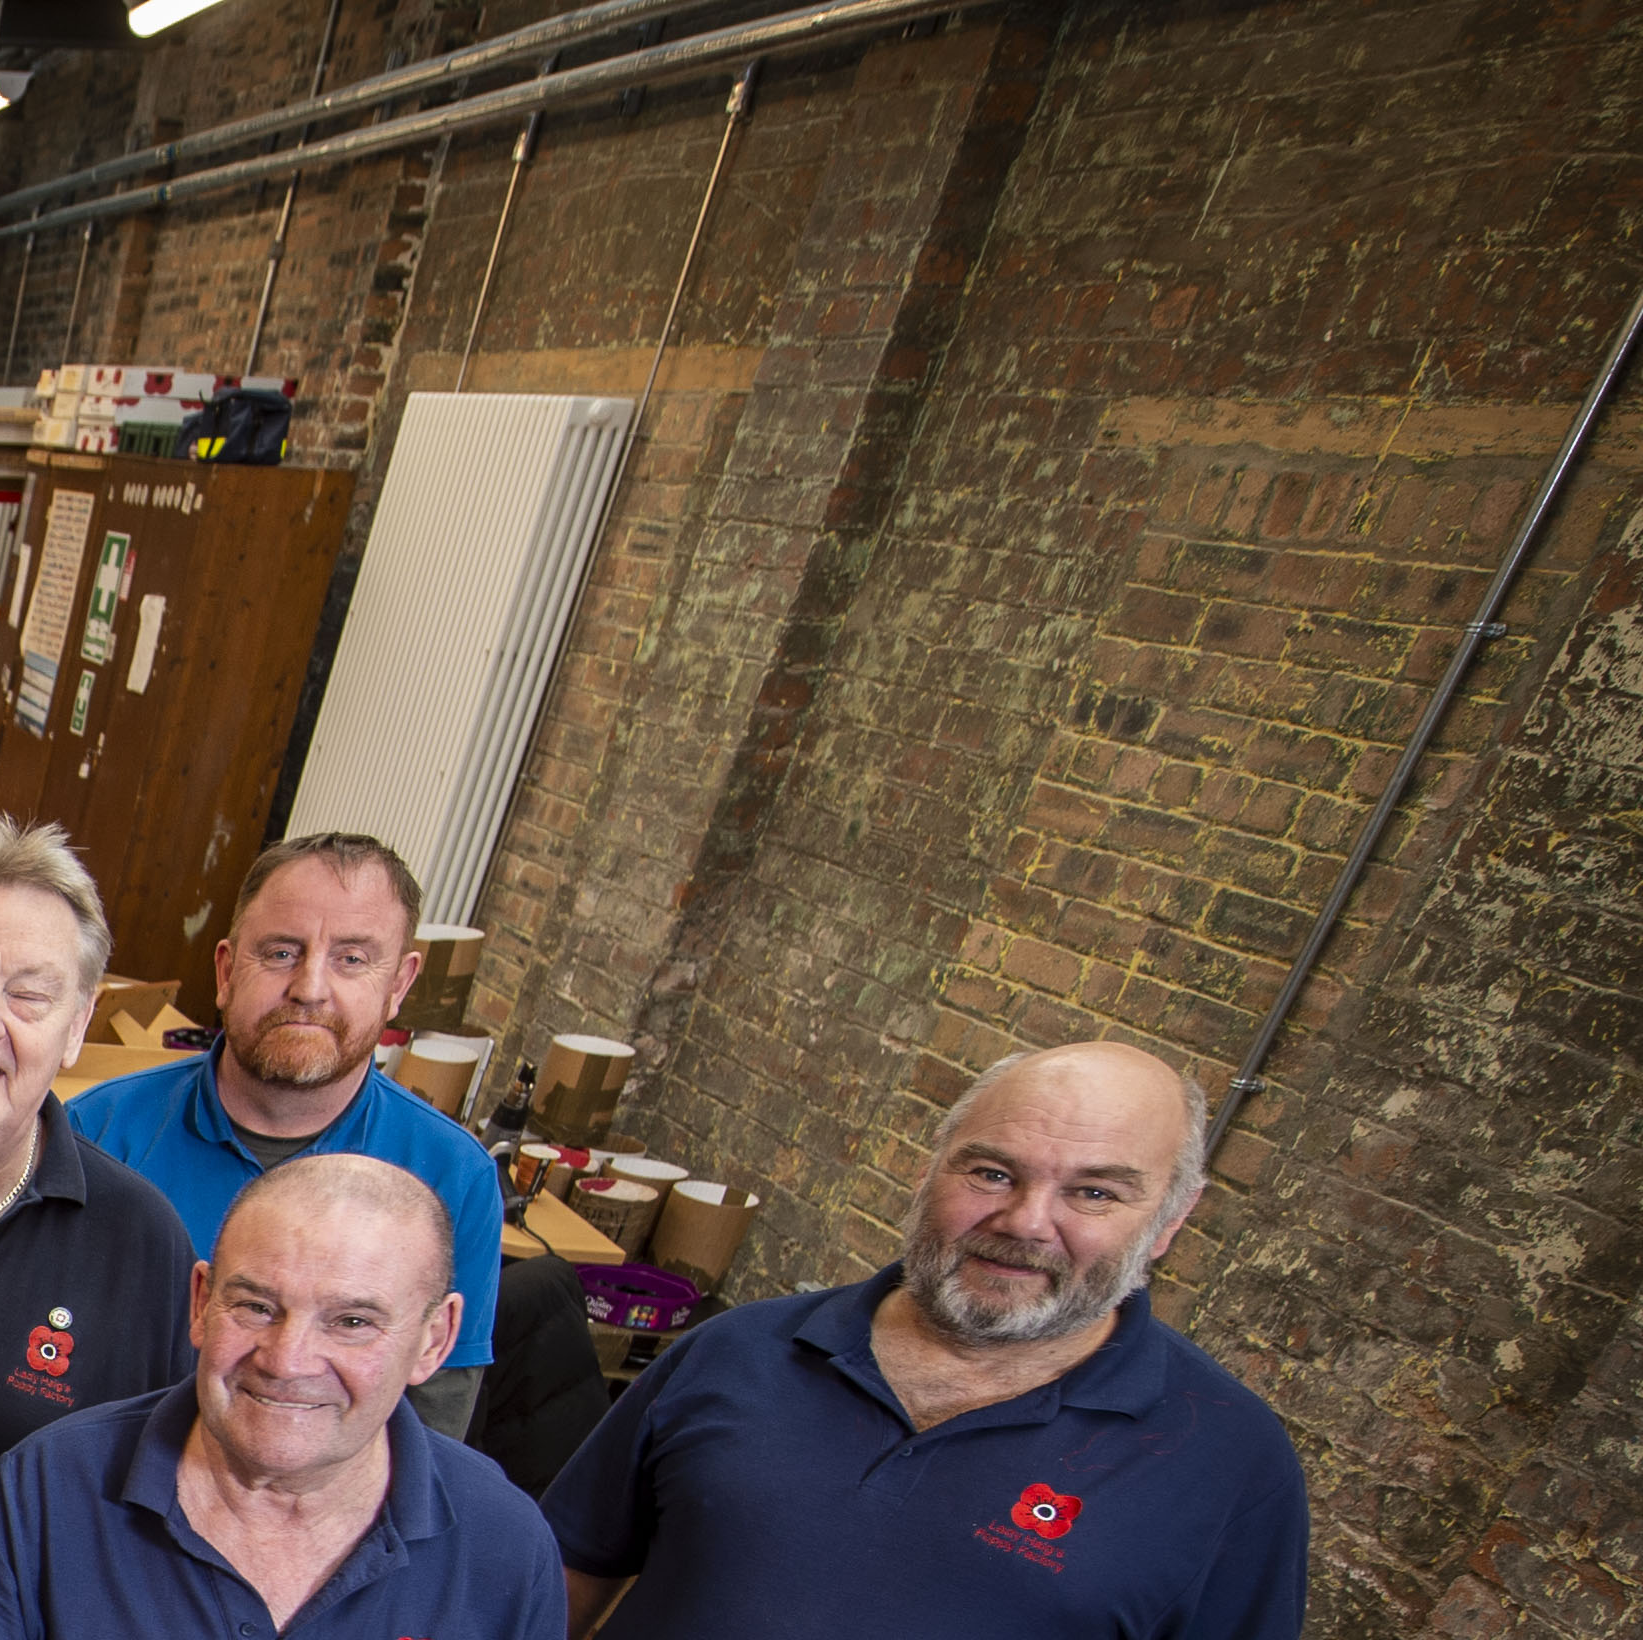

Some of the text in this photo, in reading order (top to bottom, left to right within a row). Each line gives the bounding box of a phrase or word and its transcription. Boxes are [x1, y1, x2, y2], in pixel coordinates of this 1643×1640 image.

[6, 1376, 75, 1408] Poppy Factory
[14, 1367, 72, 1394] Lady Haig's
[988, 1520, 1022, 1542] Lady
[974, 1528, 1065, 1575] Poppy Factory
